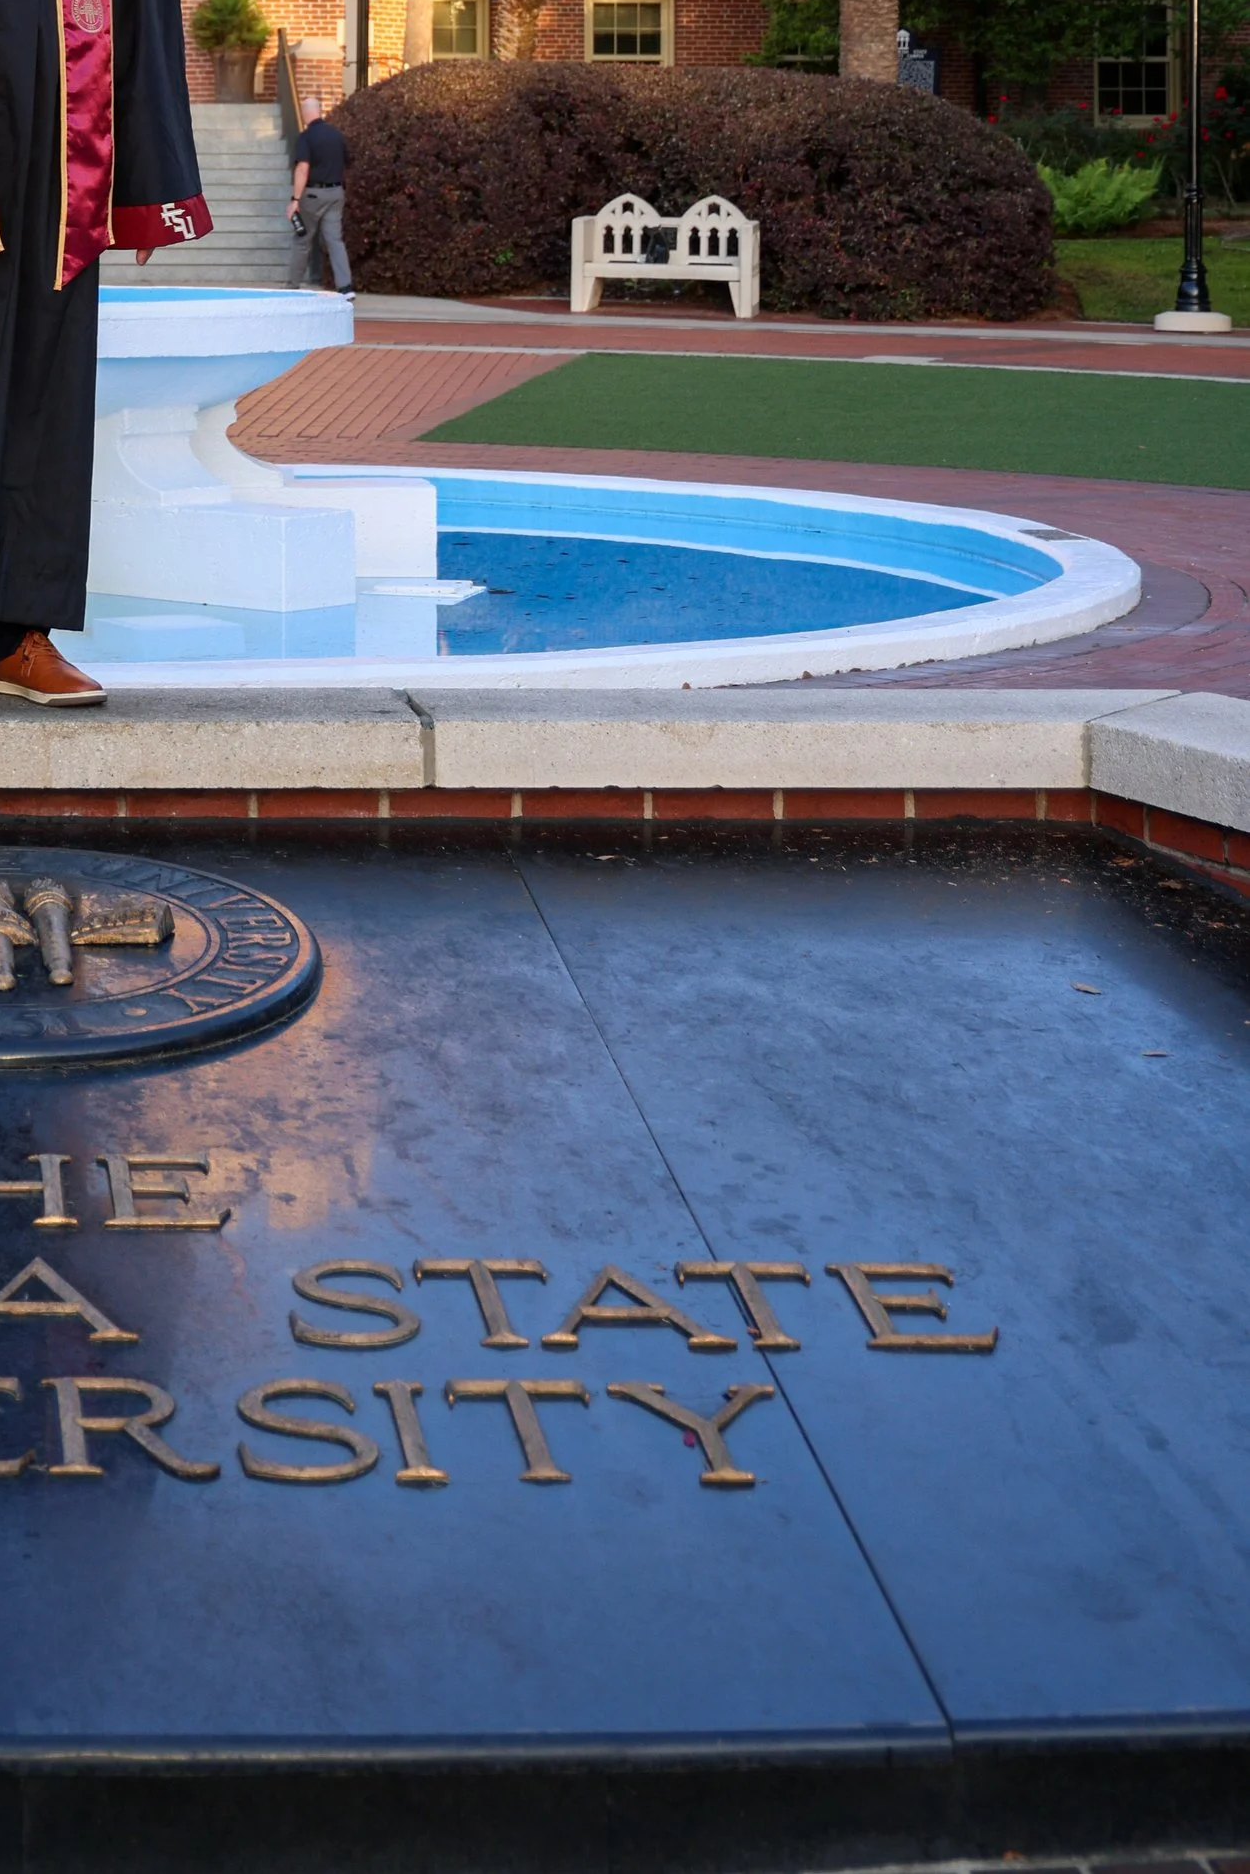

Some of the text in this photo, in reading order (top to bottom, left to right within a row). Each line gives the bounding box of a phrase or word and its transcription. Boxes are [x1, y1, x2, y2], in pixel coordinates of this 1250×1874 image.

[160, 202, 198, 240] FSU
[75, 858, 293, 1015] UNIVERSITY
[288, 1257, 1000, 1354] STATE
